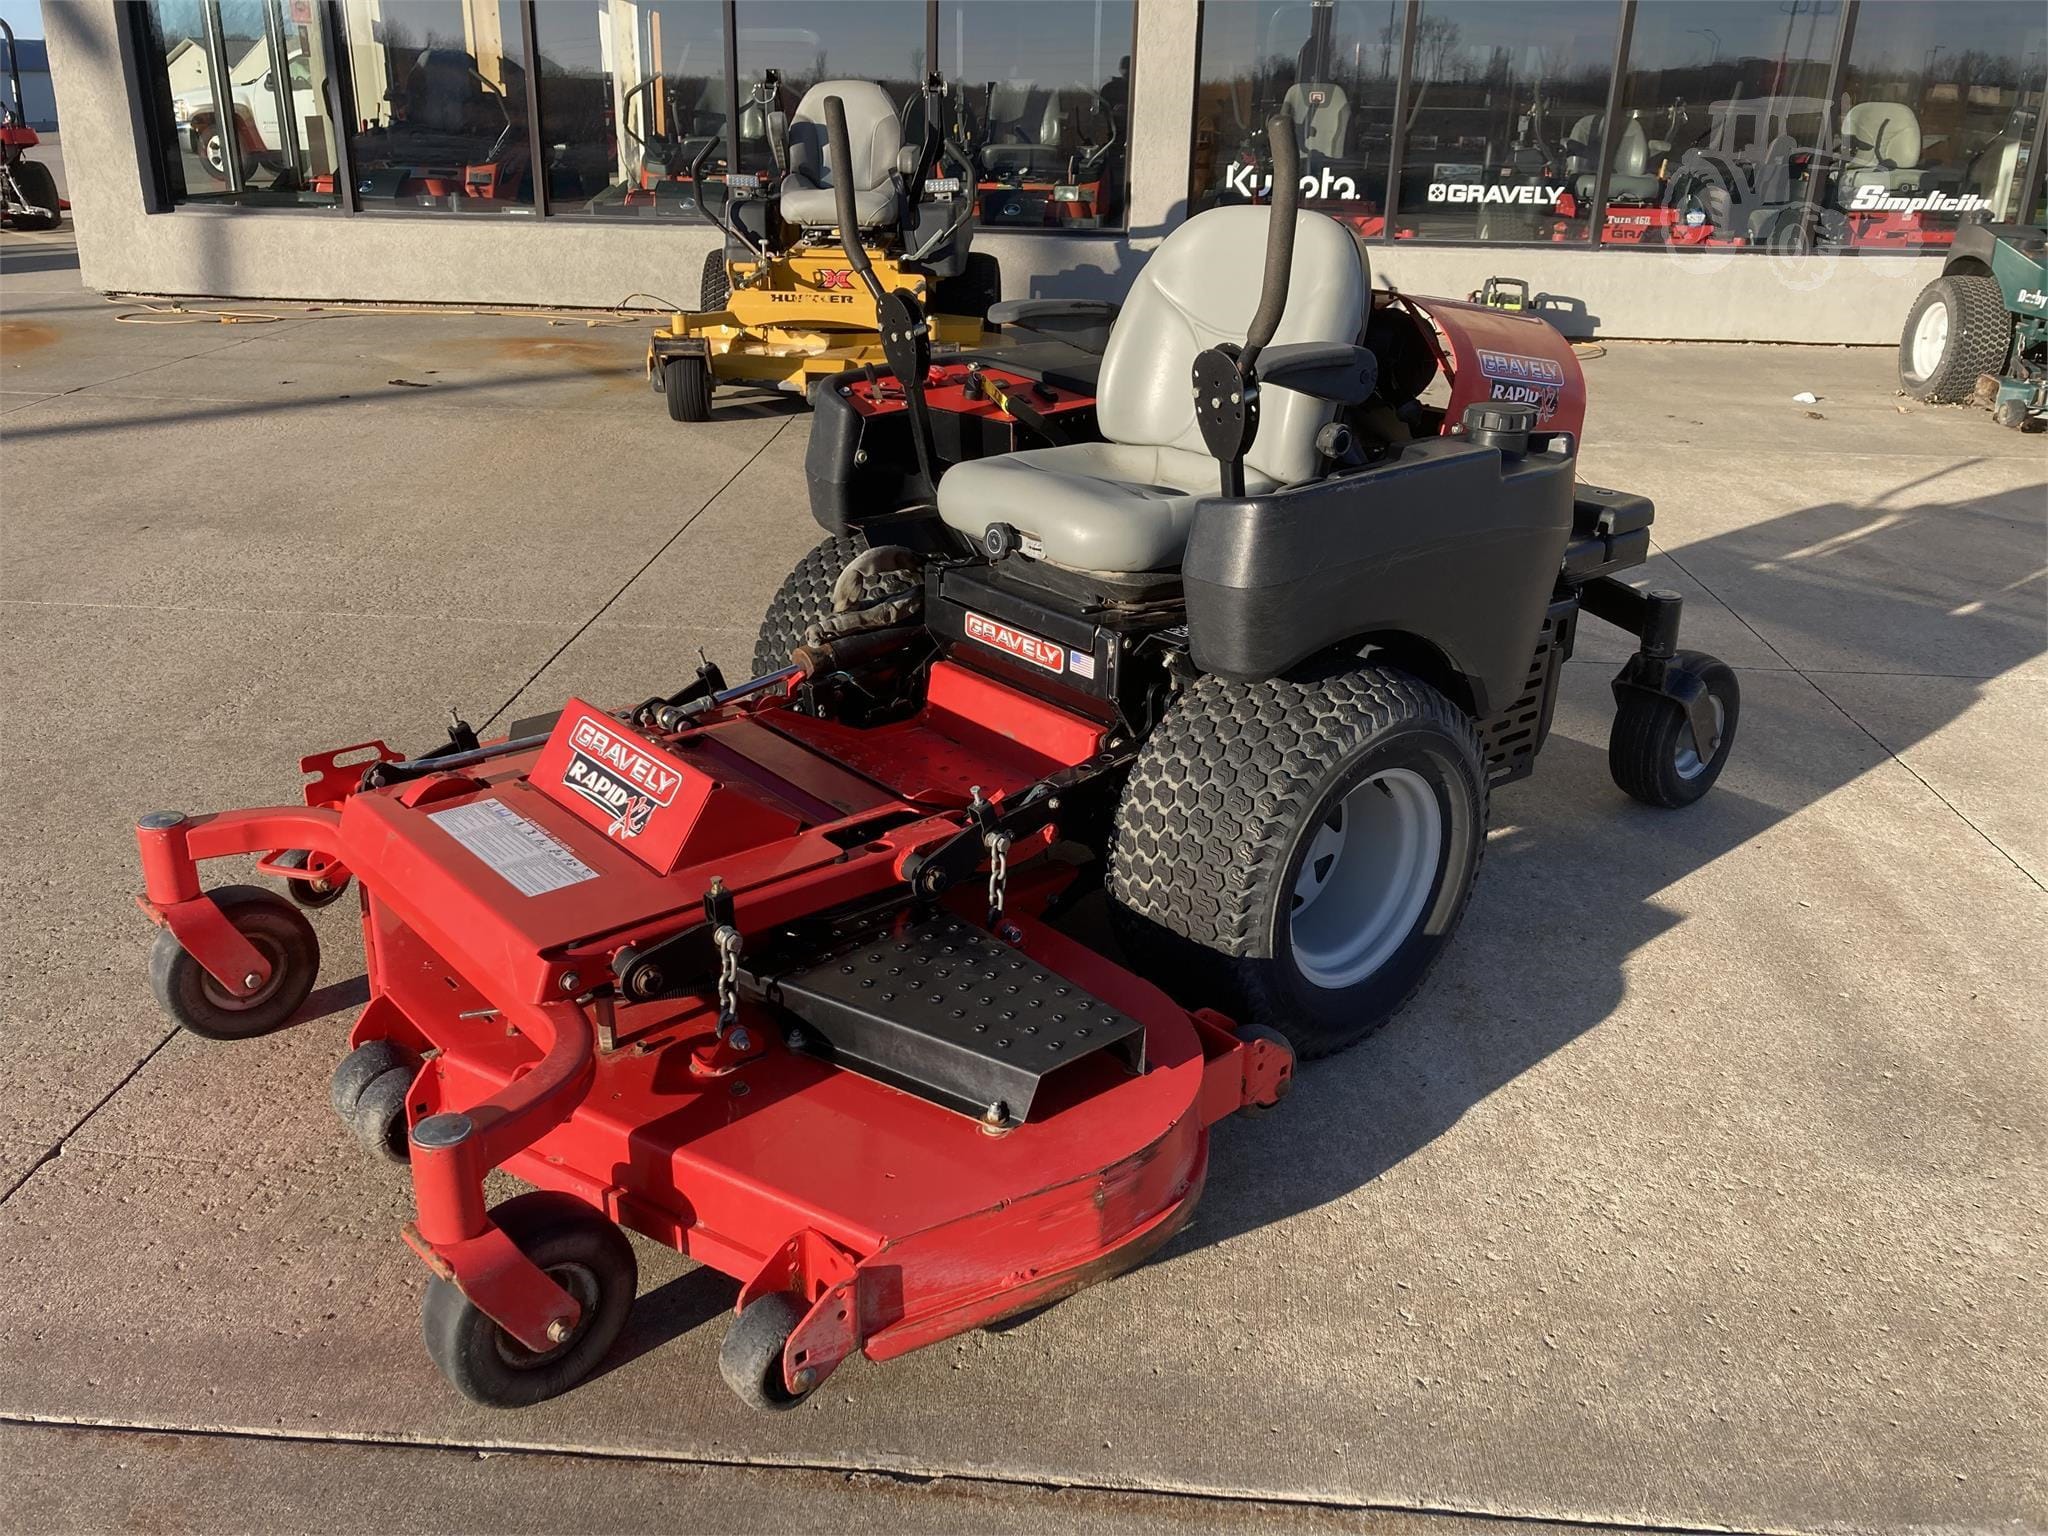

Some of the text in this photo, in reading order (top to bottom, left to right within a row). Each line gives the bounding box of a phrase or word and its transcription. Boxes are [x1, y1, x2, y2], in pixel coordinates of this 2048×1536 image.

[1447, 184, 1565, 204] GRAVELY
[1482, 354, 1557, 379] GRAVELY
[1492, 384, 1539, 403] RAPID
[969, 617, 1060, 664] GRAVELY
[575, 722, 677, 795] GRAVELY
[568, 759, 628, 807] RAPID
